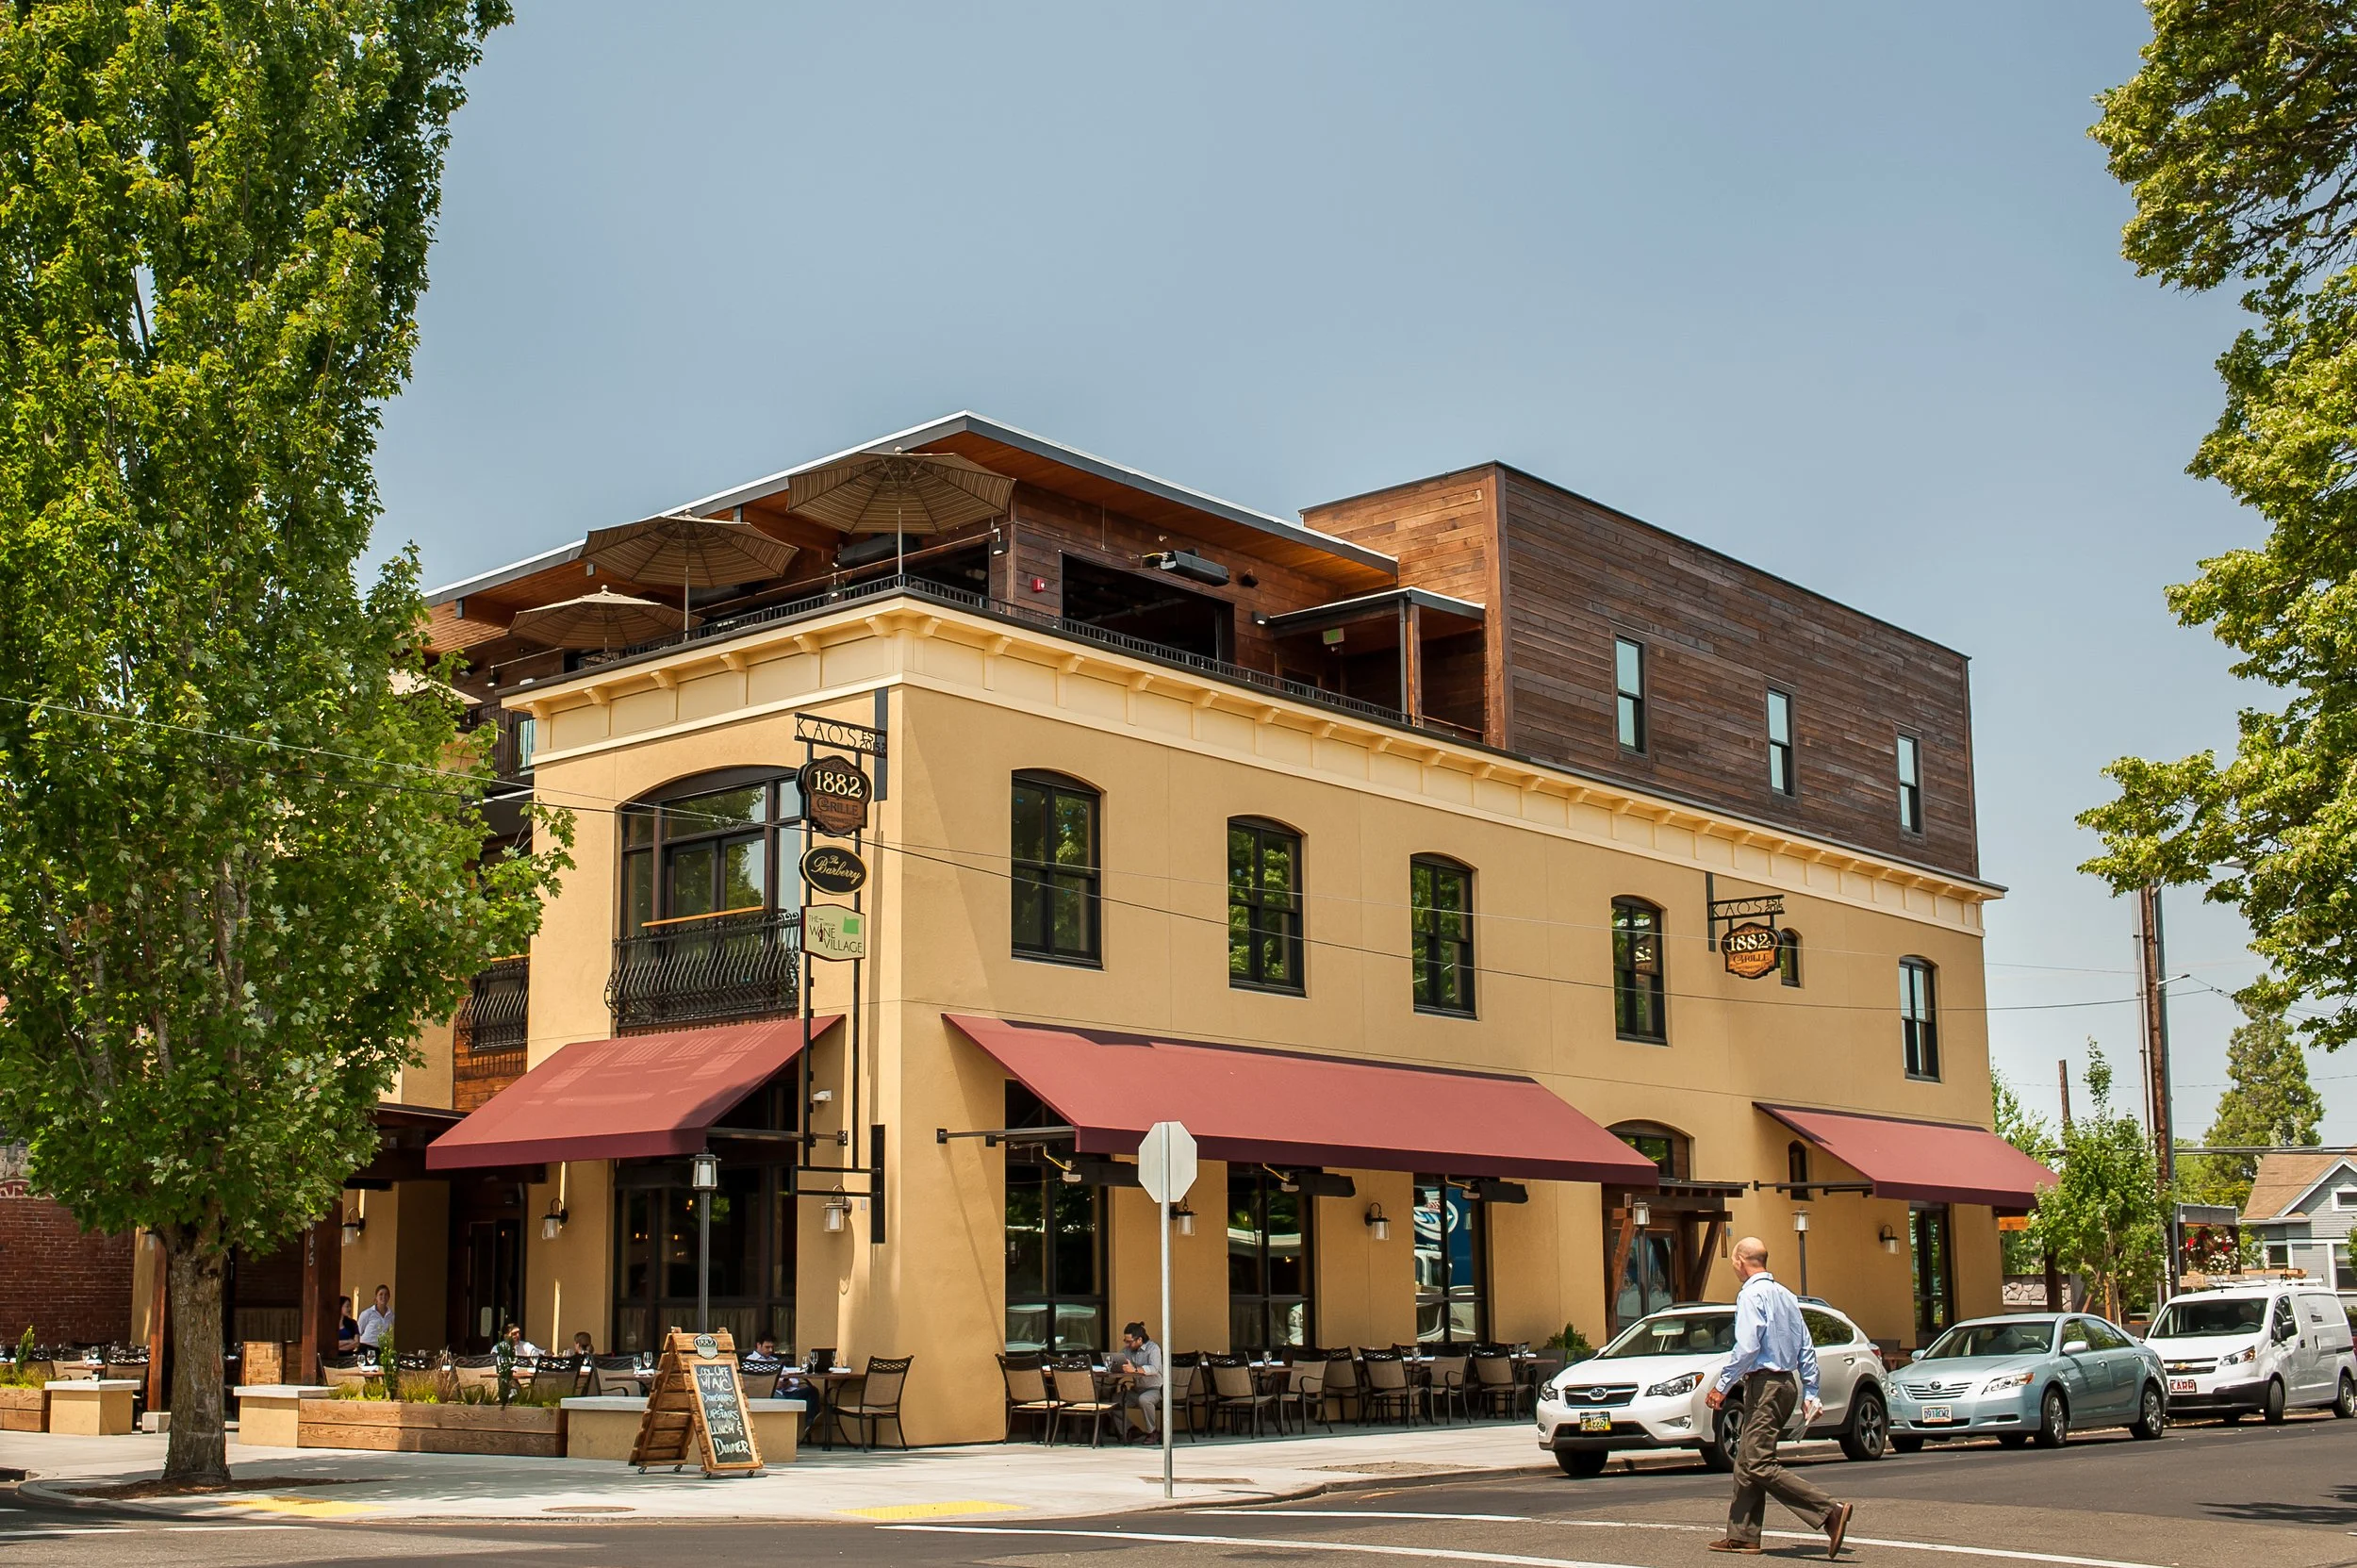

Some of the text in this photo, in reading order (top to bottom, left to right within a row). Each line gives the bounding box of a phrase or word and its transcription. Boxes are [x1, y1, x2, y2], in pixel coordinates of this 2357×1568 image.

[797, 717, 857, 748] KAOS
[815, 769, 863, 799] 1882
[816, 797, 859, 817] GRILLE
[829, 854, 839, 865] The
[811, 855, 862, 885] Barberry
[1711, 900, 1762, 917] KAOS
[808, 915, 818, 923] THE
[809, 923, 836, 943] WINE
[1729, 933, 1772, 951] 1882
[824, 937, 863, 953] VILLAGE
[2171, 1381, 2194, 1391] CARR
[709, 1420, 735, 1435] LUNCH
[713, 1437, 751, 1456] DINNER
